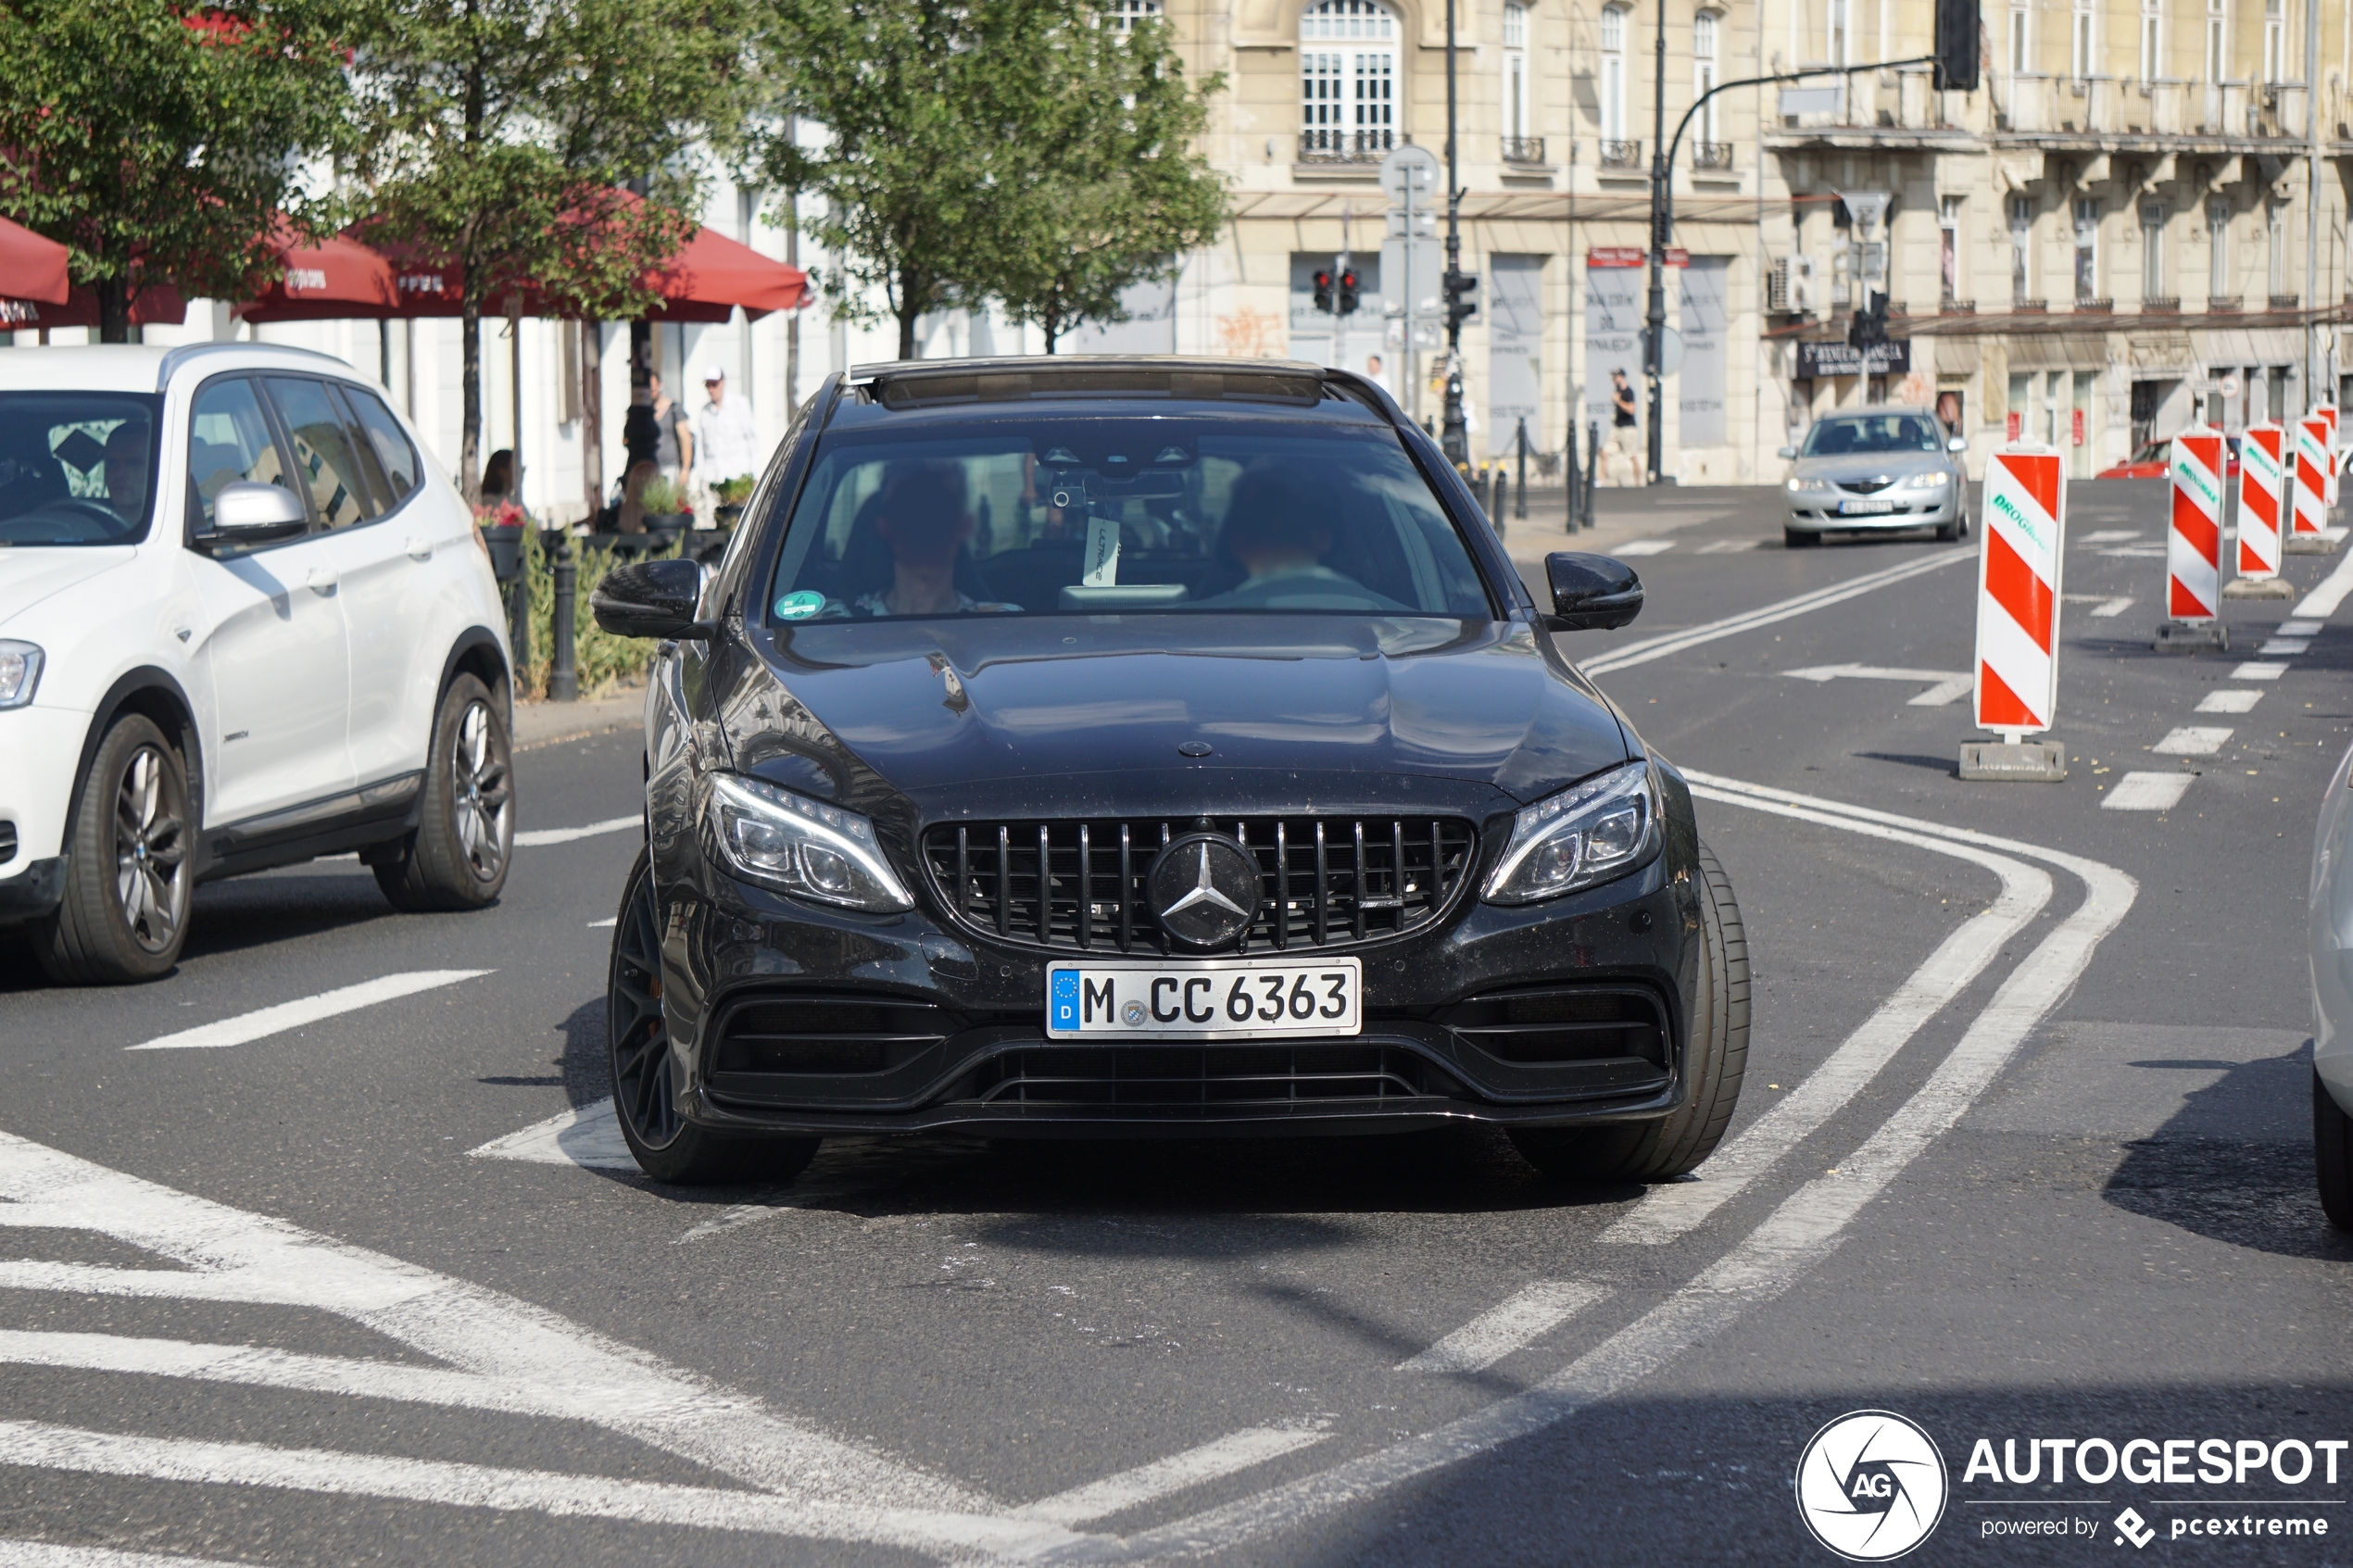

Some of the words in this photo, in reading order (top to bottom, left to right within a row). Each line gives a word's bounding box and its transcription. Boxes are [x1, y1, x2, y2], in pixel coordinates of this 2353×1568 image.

[2178, 461, 2219, 504] DROGMAX
[1095, 528, 1107, 582] ULTRACE
[794, 594, 806, 606] 4
[1061, 1005, 1072, 1020] D
[1084, 977, 1114, 1023] M
[1151, 976, 1214, 1023] CC
[1227, 973, 1347, 1022] 6363
